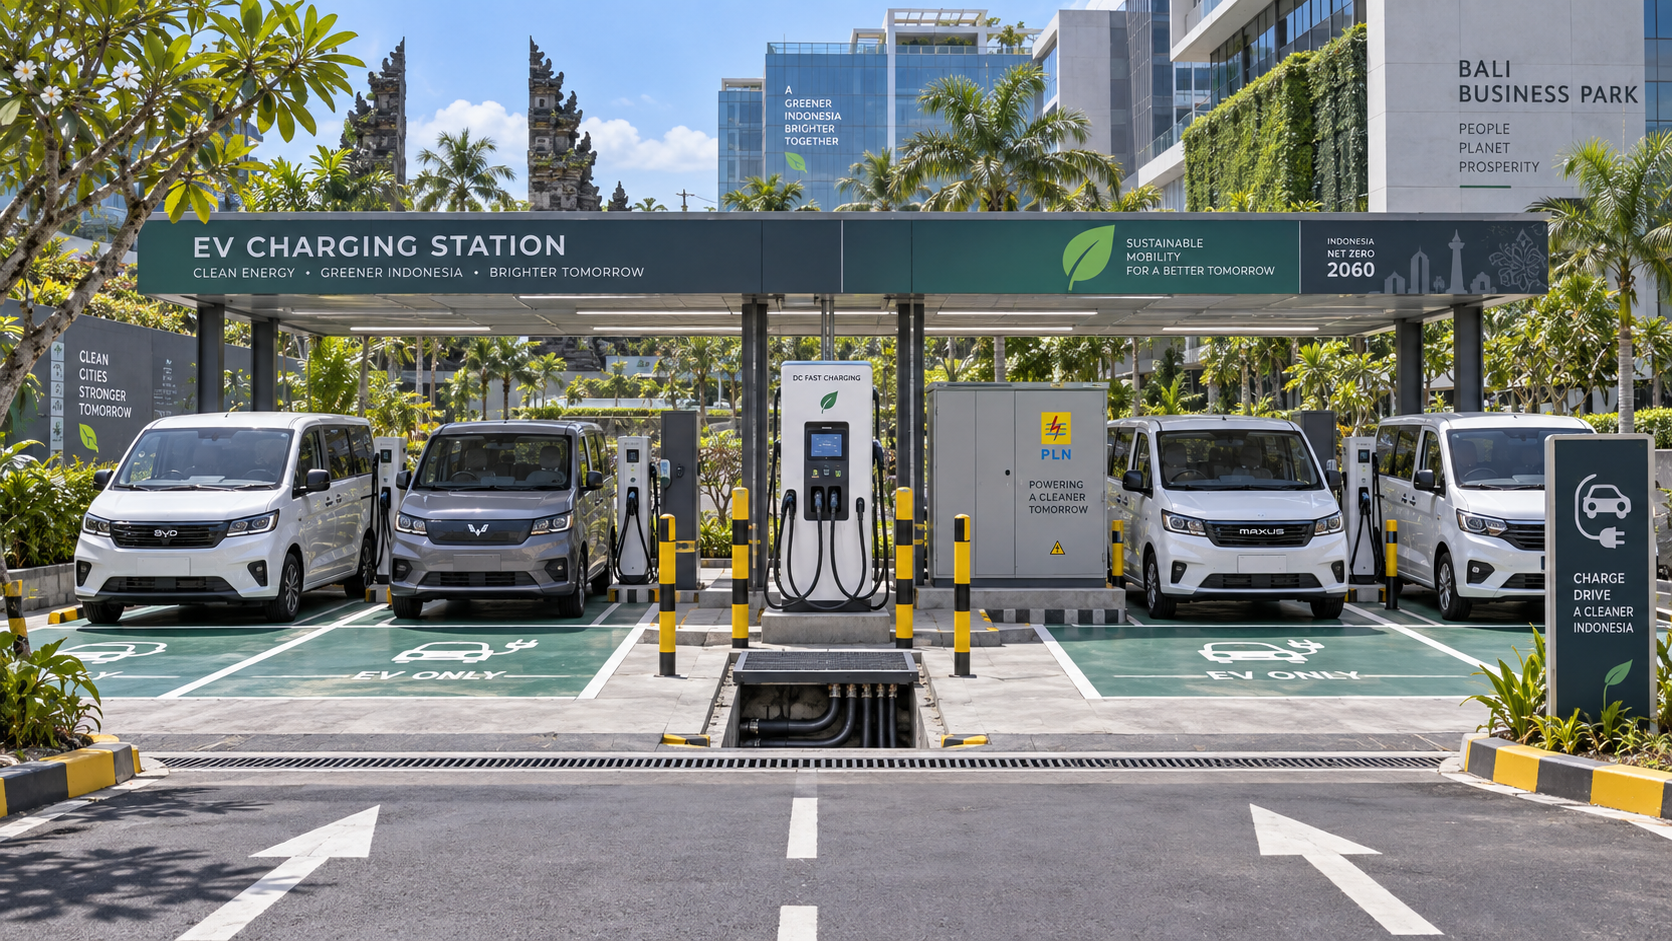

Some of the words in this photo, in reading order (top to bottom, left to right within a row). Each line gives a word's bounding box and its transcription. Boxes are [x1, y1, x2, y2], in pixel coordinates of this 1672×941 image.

[1459, 60, 1510, 78] BALI
[785, 85, 793, 95] A
[1459, 85, 1570, 103] BUSINESS
[1581, 85, 1639, 104] PARK
[784, 99, 832, 108] GREENER
[784, 111, 842, 121] INDONESIA
[784, 124, 835, 133] BRIGHTER
[1459, 123, 1510, 135] PEOPLE
[784, 137, 839, 146] TOGETHER
[1459, 142, 1511, 154] PLANET
[1459, 161, 1540, 173] PROSPERITY
[194, 236, 235, 258] EV
[246, 235, 417, 258] CHARGING
[430, 234, 565, 257] STATION
[1126, 238, 1204, 248] SUSTAINABLE
[1327, 237, 1375, 246] INDONESIA
[1126, 252, 1181, 262] MOBILITY
[1327, 249, 1346, 258] NET
[1349, 249, 1375, 258] ZERO
[193, 267, 237, 278] CLEAN
[242, 267, 295, 278] ENERGY
[320, 267, 383, 278] GREENER
[388, 267, 463, 278] INDONESIA
[489, 267, 557, 278] BRIGHTER
[562, 266, 645, 278] TOMORROW
[1126, 266, 1149, 276] FOR
[1152, 266, 1160, 276] A
[1163, 266, 1205, 276] BETTER
[1207, 266, 1276, 276] TOMORROW
[1327, 262, 1375, 277] 2060
[79, 350, 109, 366] CLEAN
[79, 368, 108, 383] CITIES
[79, 385, 126, 402] STRONGER
[78, 402, 132, 418] TOMORROW
[1041, 449, 1072, 460] PLN
[1029, 480, 1084, 489] POWERING
[1029, 493, 1037, 501] A
[1039, 493, 1086, 501] CLEANER
[1029, 505, 1089, 514] TOMORROW
[153, 529, 178, 538] BYD
[1573, 572, 1625, 584] CHARGE
[1573, 589, 1611, 601] DRIVE
[1573, 606, 1582, 617] A
[1584, 606, 1634, 617] CLEANER
[1573, 622, 1634, 633] INDONESIA
[351, 670, 406, 680] EV
[412, 670, 507, 680] ONLY
[1206, 670, 1253, 680] EV
[1267, 670, 1361, 680] ONLY
